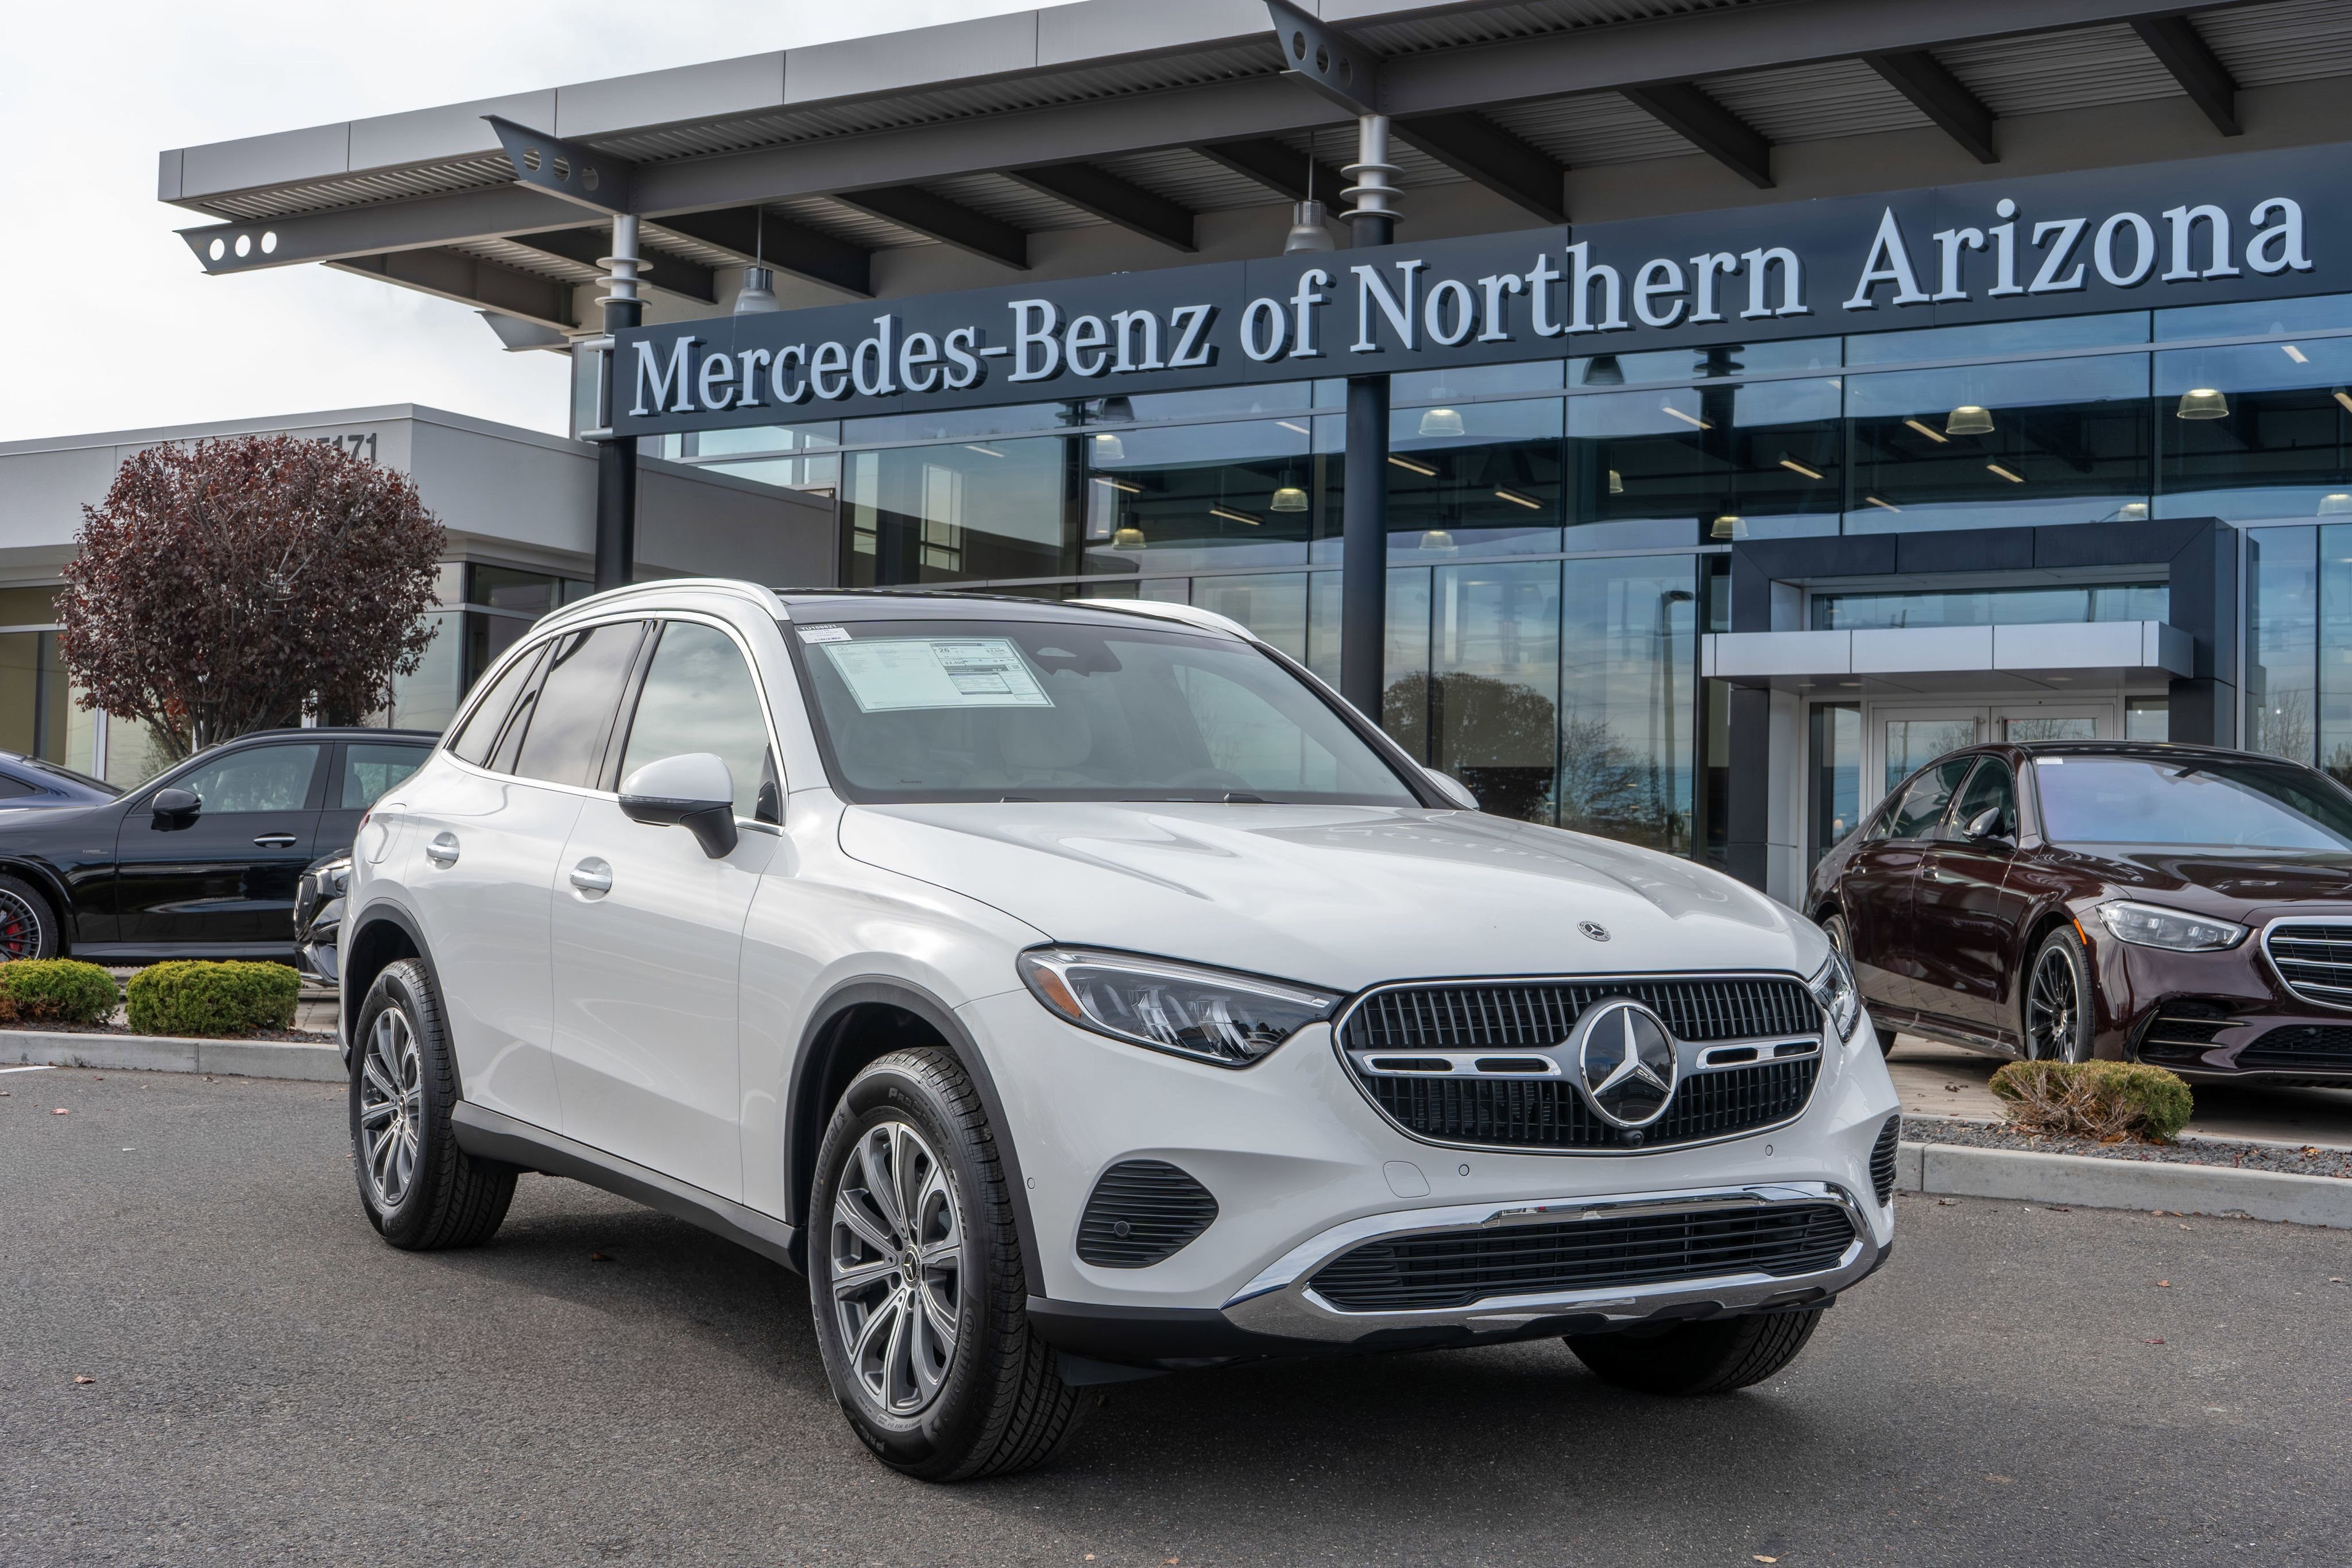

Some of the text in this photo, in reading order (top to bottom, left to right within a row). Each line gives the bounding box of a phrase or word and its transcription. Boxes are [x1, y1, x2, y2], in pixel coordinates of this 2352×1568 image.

[629, 197, 2316, 417] Mercedes-Benz of Northern Arizona
[316, 433, 377, 464] 171
